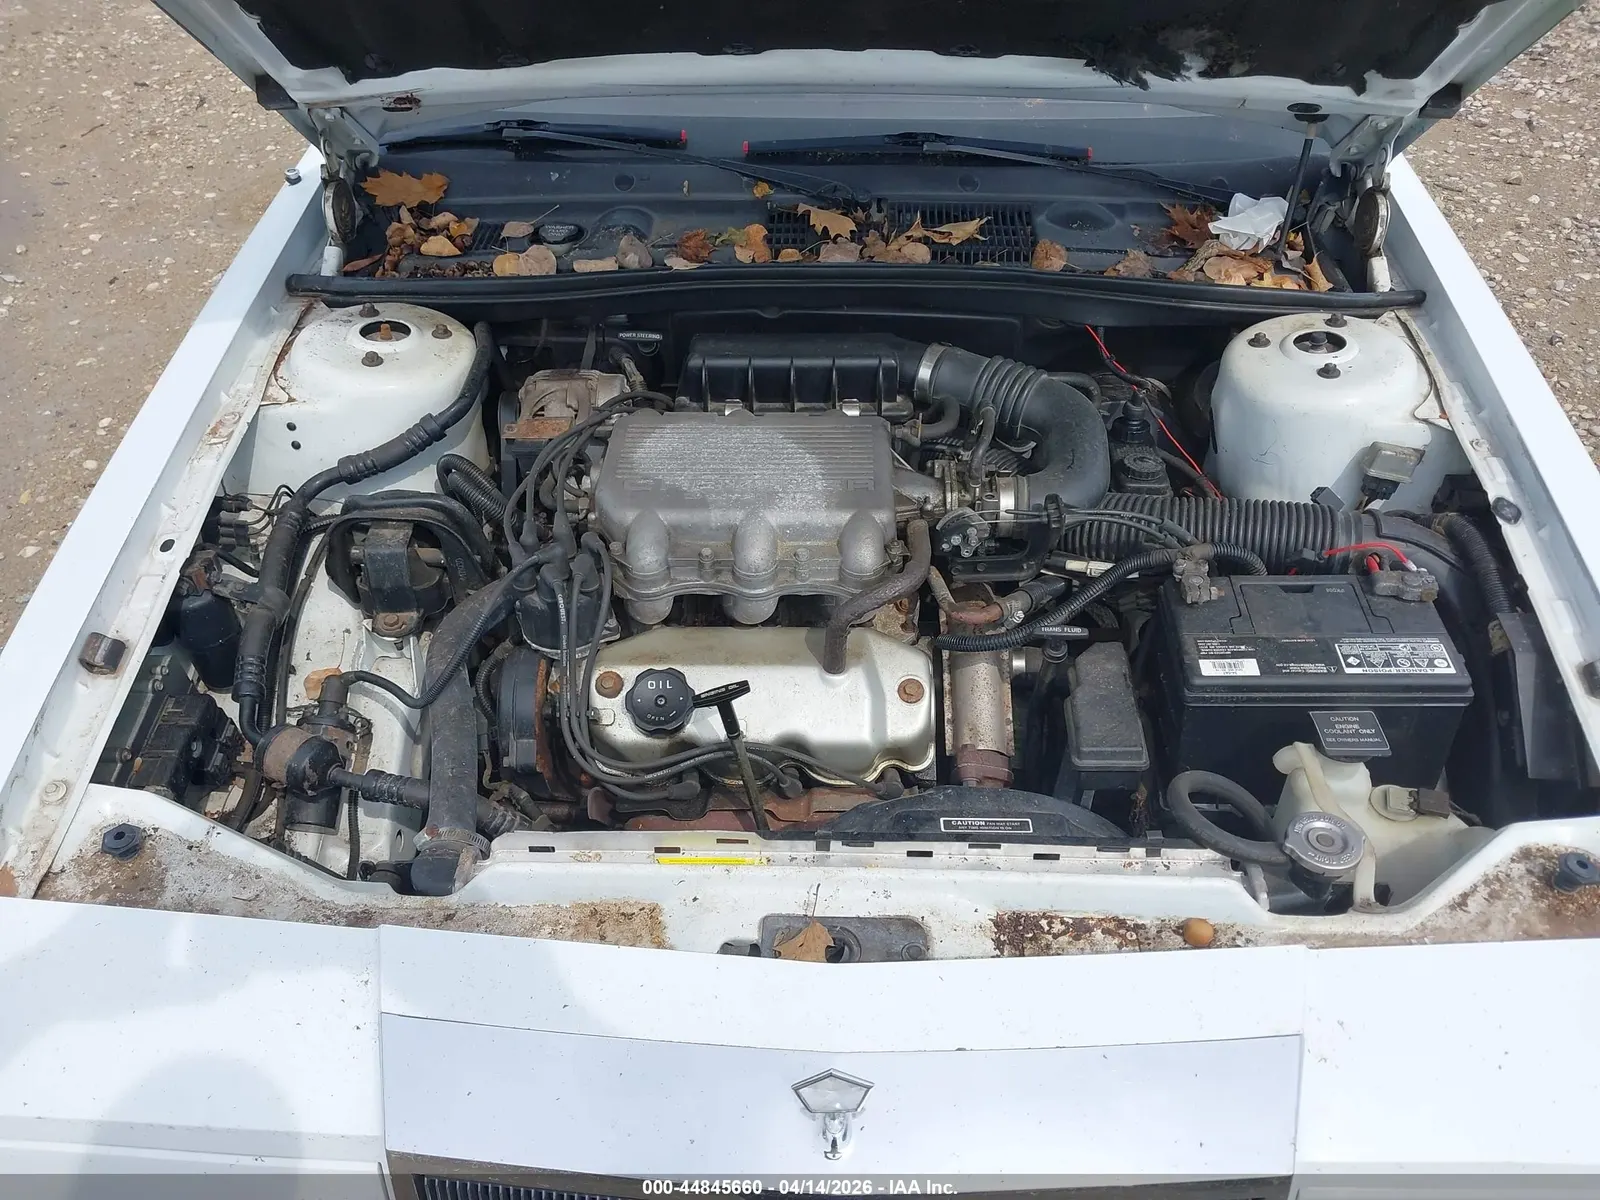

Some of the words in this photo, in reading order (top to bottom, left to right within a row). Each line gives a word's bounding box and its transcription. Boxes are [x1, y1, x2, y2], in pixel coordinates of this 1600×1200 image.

[647, 680, 673, 689] OIL
[700, 687, 726, 698] ENGINE
[646, 713, 665, 721] OPEN
